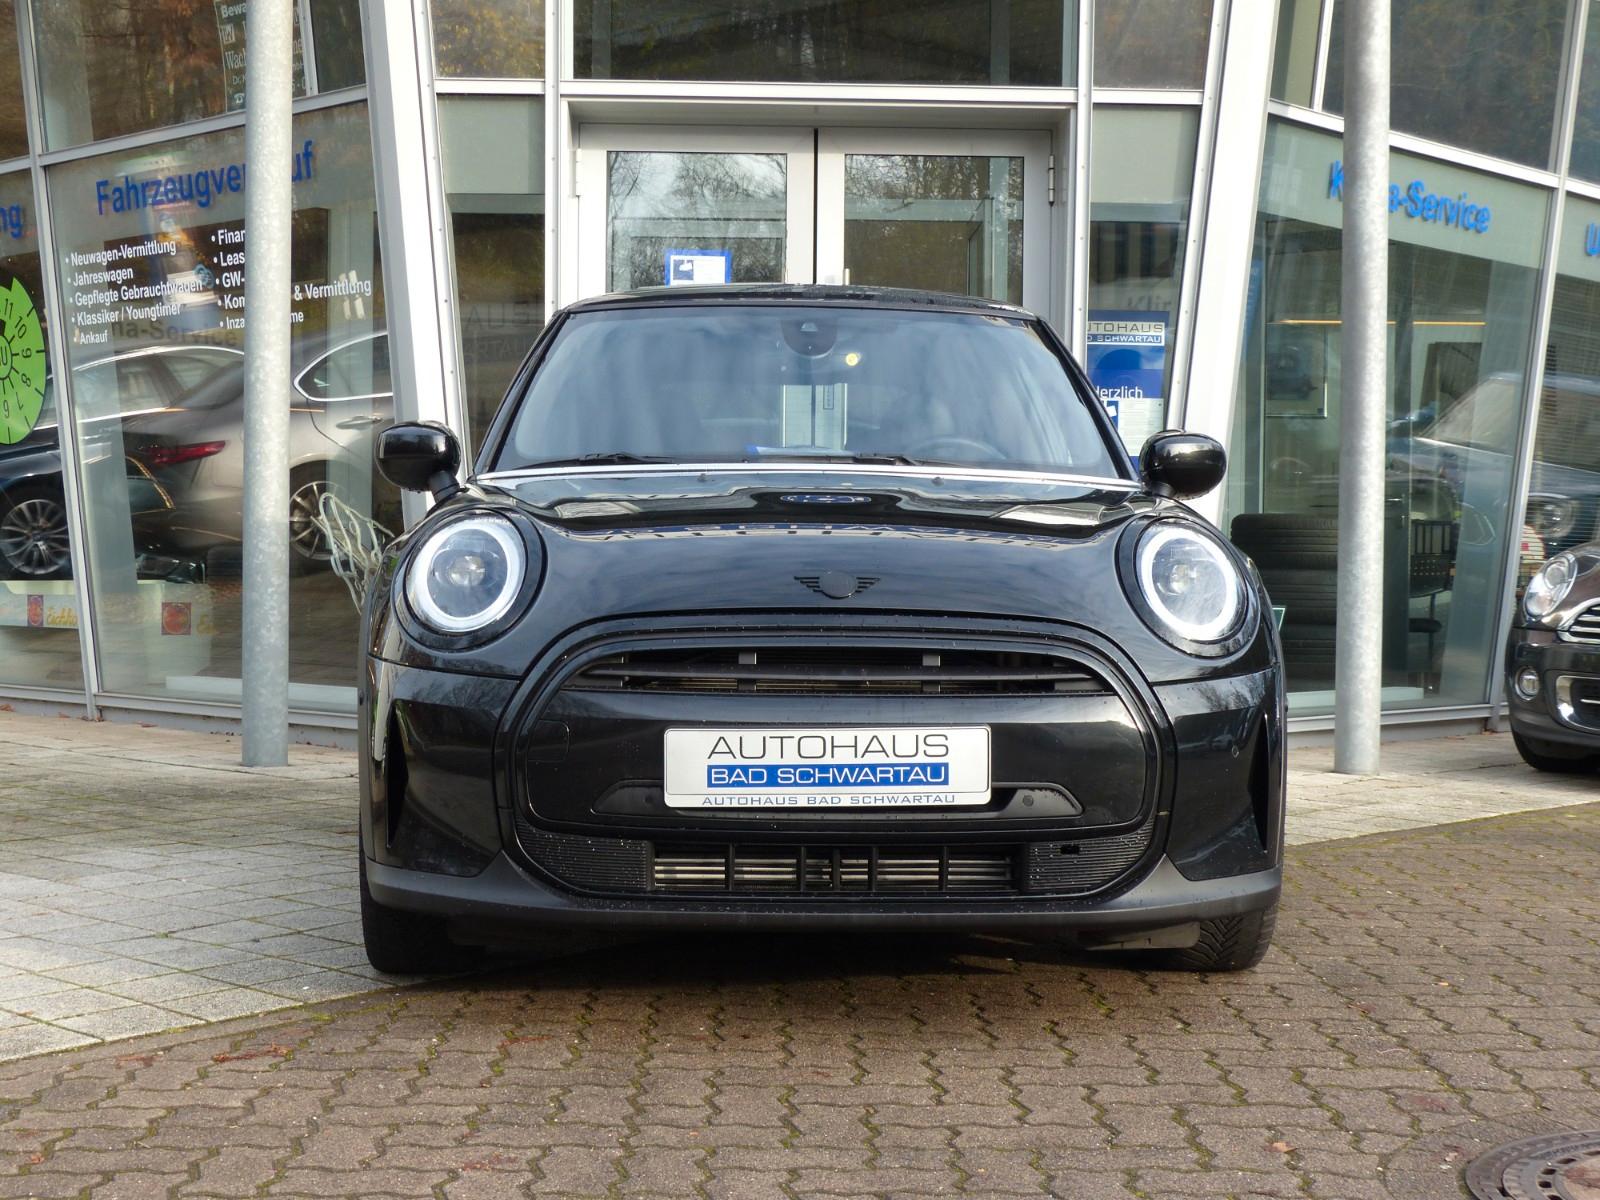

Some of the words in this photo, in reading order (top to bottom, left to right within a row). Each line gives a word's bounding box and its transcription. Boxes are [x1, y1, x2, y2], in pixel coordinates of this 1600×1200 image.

[70, 240, 177, 266] Neuwagen-Vermittlung
[219, 252, 246, 267] Leas
[73, 268, 134, 287] Jahreswagen
[75, 289, 119, 309] Gepflegte
[120, 279, 203, 301] Gebrauchtwagen
[305, 279, 372, 300] Vermittlung
[76, 309, 120, 326] Klassiker
[126, 303, 182, 322] Youngtimer
[79, 330, 108, 345] Ankauf
[707, 734, 950, 760] AUTOHAUS
[711, 767, 767, 785] BAD
[777, 764, 946, 784] SCHWARTAU
[702, 795, 798, 807] AUTOHAUS
[807, 795, 842, 806] BAD
[851, 793, 955, 806] SCHWARTAU
